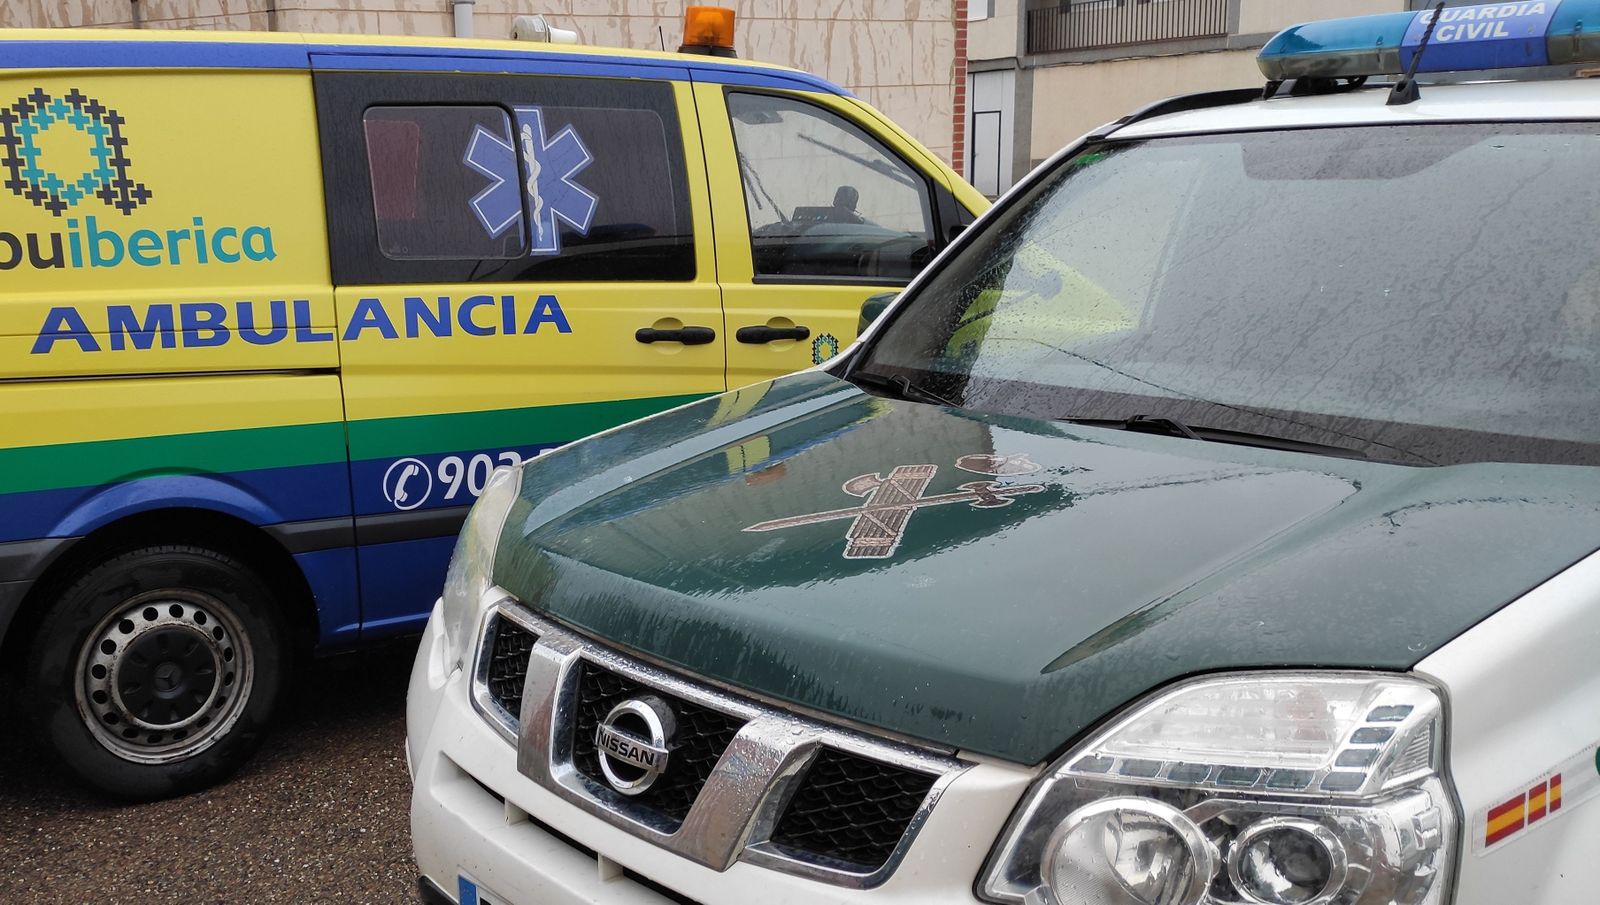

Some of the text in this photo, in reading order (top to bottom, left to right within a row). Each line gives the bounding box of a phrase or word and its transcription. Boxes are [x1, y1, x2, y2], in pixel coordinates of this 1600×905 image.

[1435, 21, 1509, 42] CIVIL
[30, 295, 573, 354] AMBULANCIA
[597, 729, 655, 766] NISSAN
